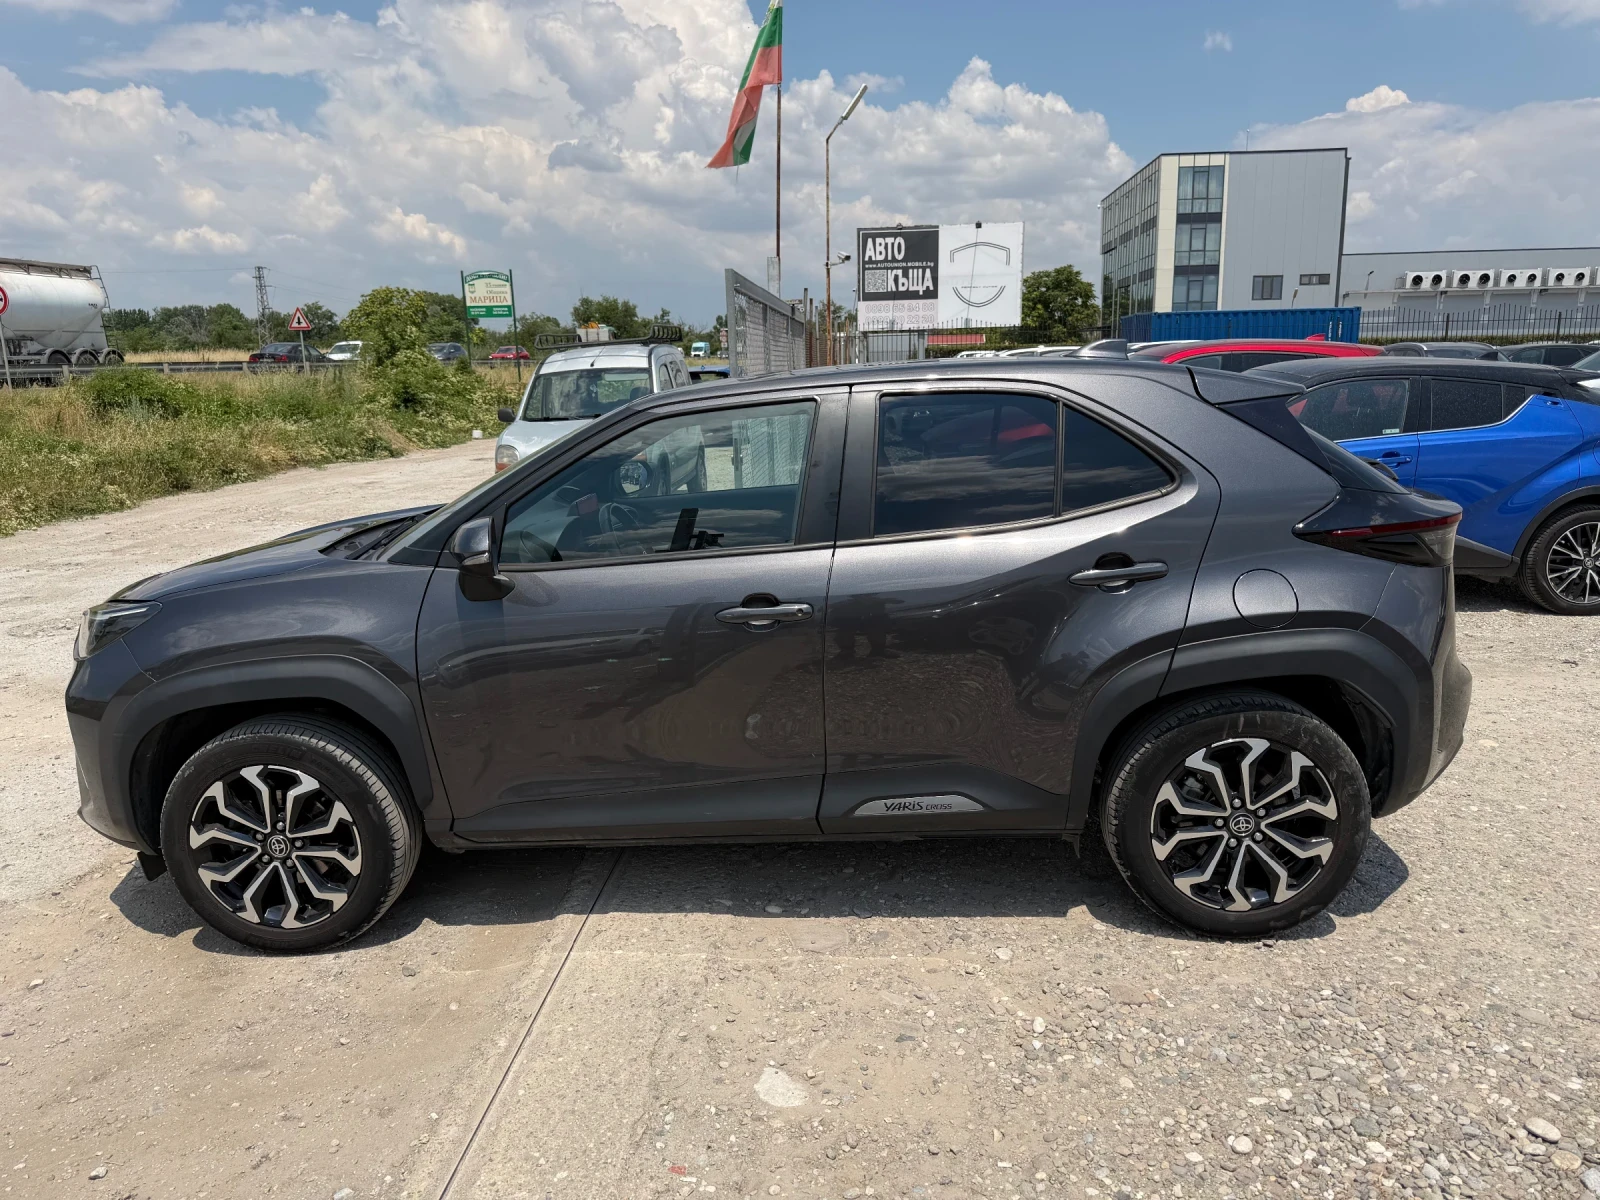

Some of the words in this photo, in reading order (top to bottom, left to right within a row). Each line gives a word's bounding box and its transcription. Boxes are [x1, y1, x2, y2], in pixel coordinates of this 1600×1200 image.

[864, 236, 905, 261] АВТО
[887, 268, 934, 295] КЪЩА
[469, 295, 508, 304] МАРИЦА
[865, 303, 890, 314] 0898
[907, 302, 920, 313] 34
[907, 314, 920, 325] 22
[925, 803, 952, 811] CROSS
